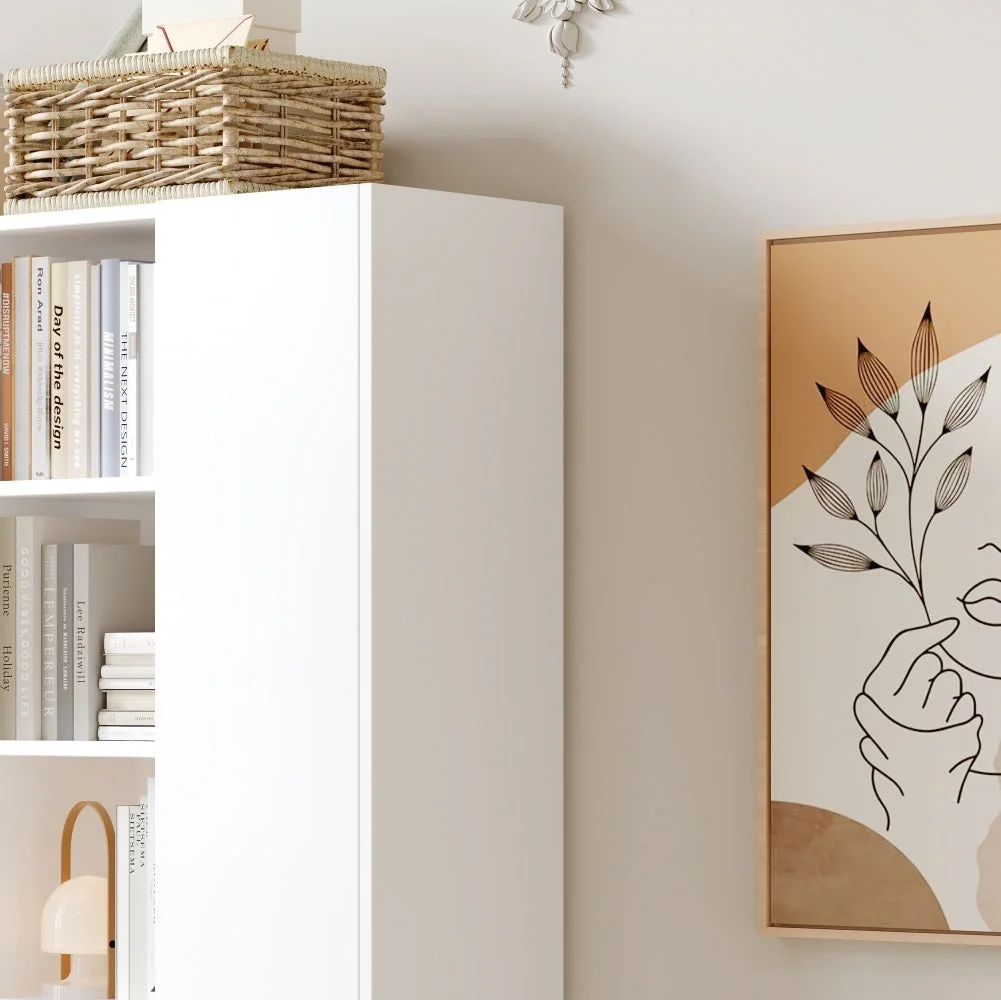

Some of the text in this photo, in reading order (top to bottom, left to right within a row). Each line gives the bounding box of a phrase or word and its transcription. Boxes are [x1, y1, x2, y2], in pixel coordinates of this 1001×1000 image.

[2, 293, 10, 374] #DISRUPTMENOW
[103, 331, 114, 411] MINIMALISM
[53, 305, 63, 449] Day of the design
[21, 548, 29, 588] GOOD
[1, 565, 12, 692] Purienne Holiday
[76, 601, 85, 684] Lee Radziwill
